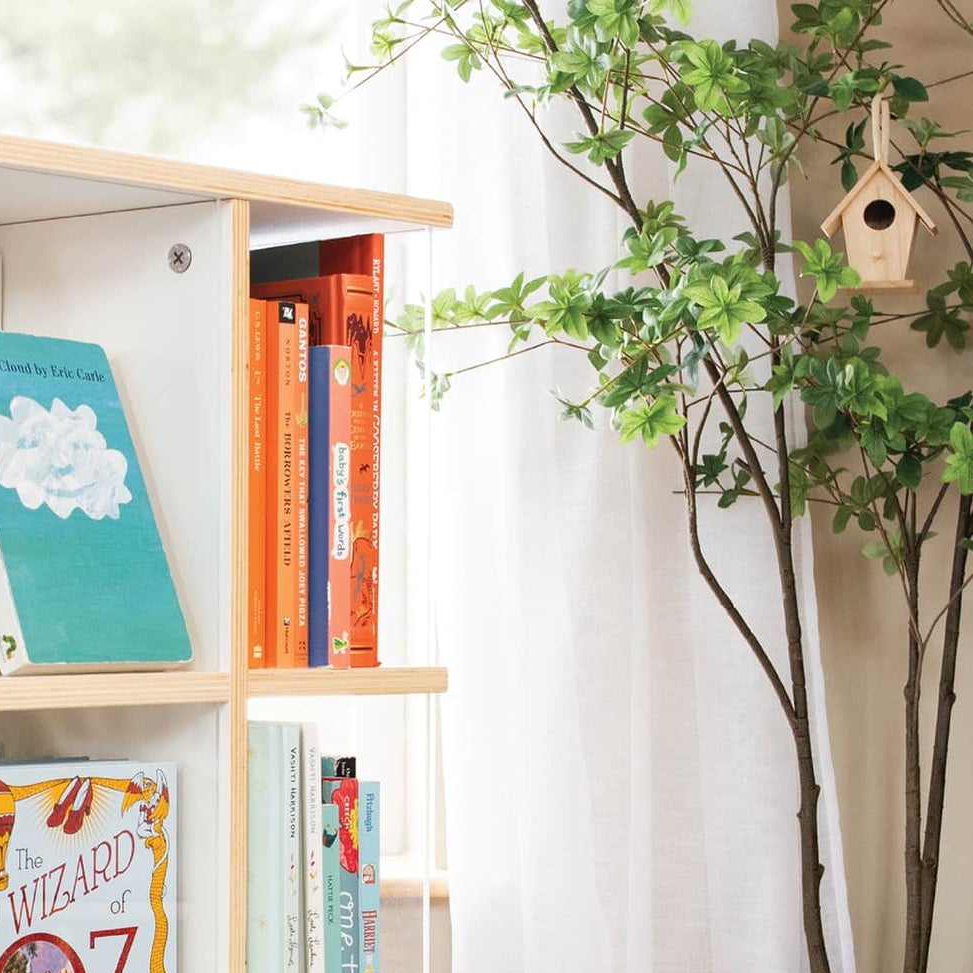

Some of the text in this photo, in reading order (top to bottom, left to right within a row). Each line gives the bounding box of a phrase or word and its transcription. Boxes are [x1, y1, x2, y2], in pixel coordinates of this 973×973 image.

[32, 363, 49, 379] by
[51, 364, 75, 380] Eric
[76, 368, 106, 383] Carle
[298, 318, 308, 383] GANTOS
[283, 433, 292, 567] BORROWERS AFIELD
[298, 481, 306, 506] THAT
[335, 446, 348, 557] baby's first words
[298, 507, 306, 568] SWALLOWED
[298, 570, 306, 597] JOEY
[365, 792, 375, 833] Fitzhugh
[15, 847, 44, 871] The
[7, 829, 137, 935] WIZARD
[109, 888, 133, 916] of
[339, 891, 355, 947] one
[361, 909, 378, 954] HARRIET
